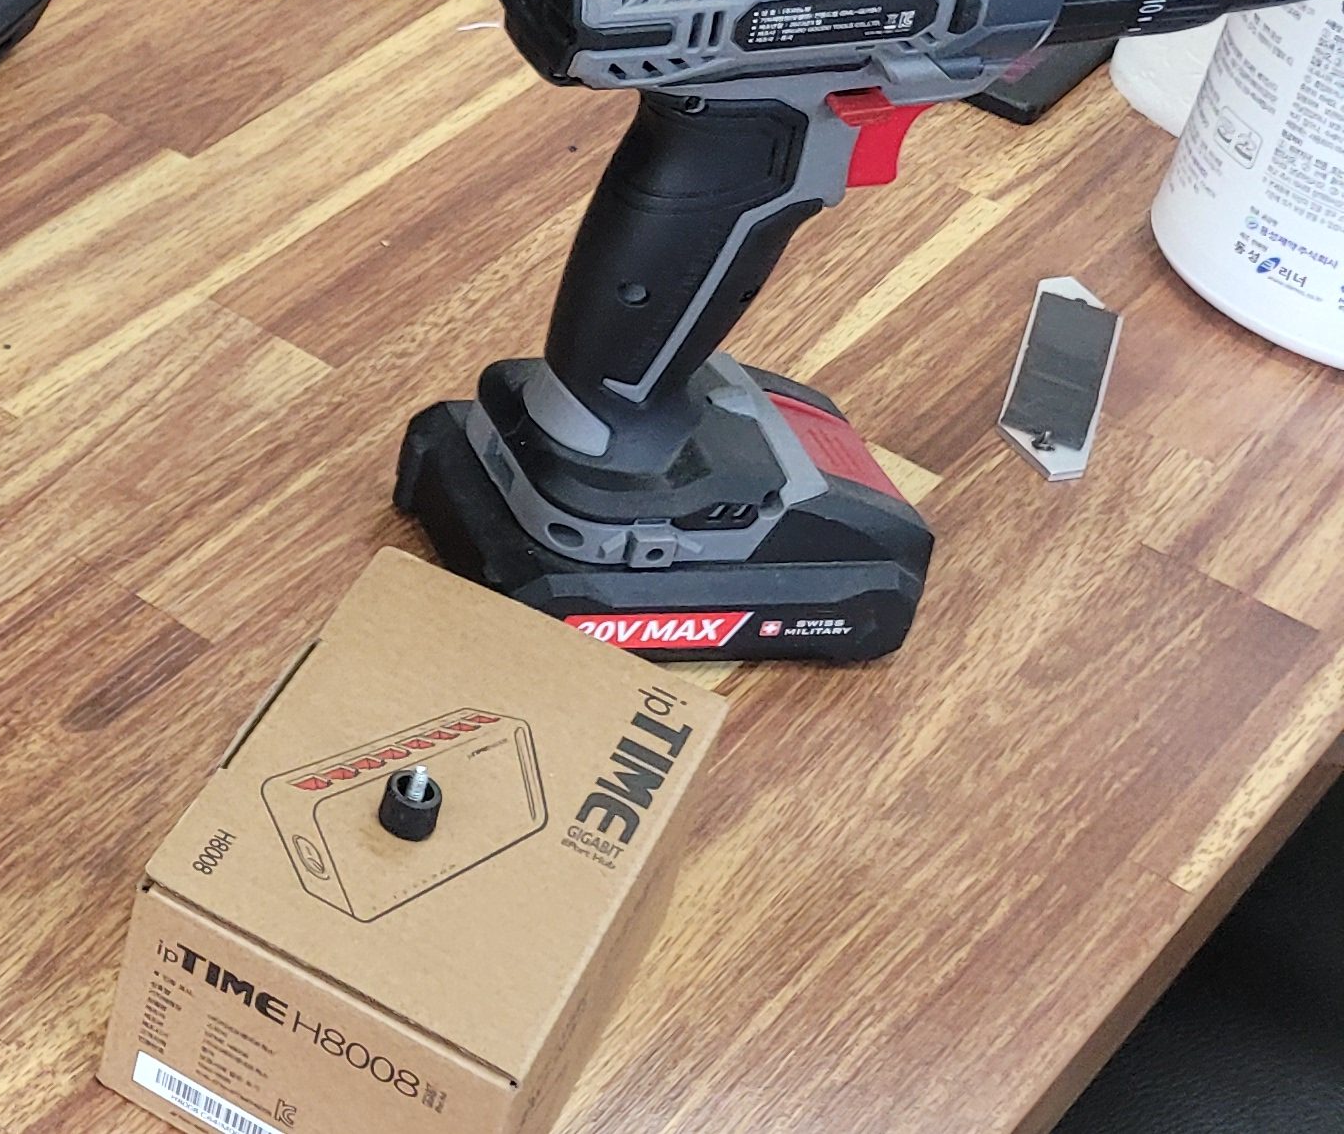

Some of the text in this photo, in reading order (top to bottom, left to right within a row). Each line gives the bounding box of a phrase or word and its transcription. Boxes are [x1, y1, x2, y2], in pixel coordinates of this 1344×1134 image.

[641, 617, 726, 643] MAX
[783, 626, 853, 637] MILITARY
[795, 619, 846, 629] SWISS
[575, 685, 693, 845] ipTIME
[192, 828, 236, 875] H8008
[567, 825, 624, 859] GIGABIT
[156, 939, 289, 1026] ipTIME
[291, 1010, 421, 1098] H8008
